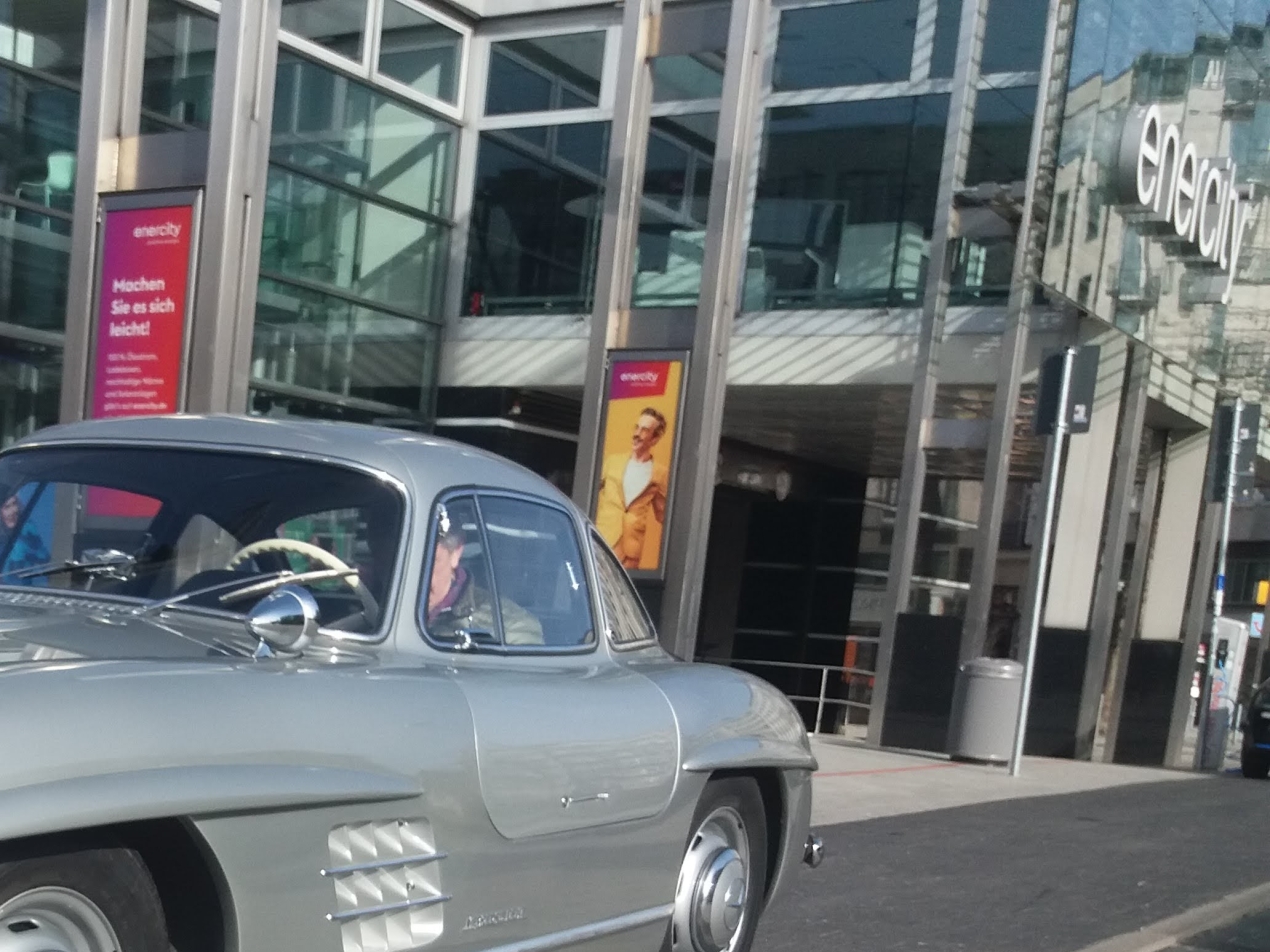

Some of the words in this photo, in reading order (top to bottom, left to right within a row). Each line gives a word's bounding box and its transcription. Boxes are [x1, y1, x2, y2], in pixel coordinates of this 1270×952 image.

[1137, 104, 1250, 304] enercity
[133, 222, 181, 238] enercity
[112, 277, 165, 293] Machen
[110, 299, 130, 315] Sie
[132, 302, 147, 314] es
[149, 297, 175, 313] sich
[109, 320, 150, 336] leicht!
